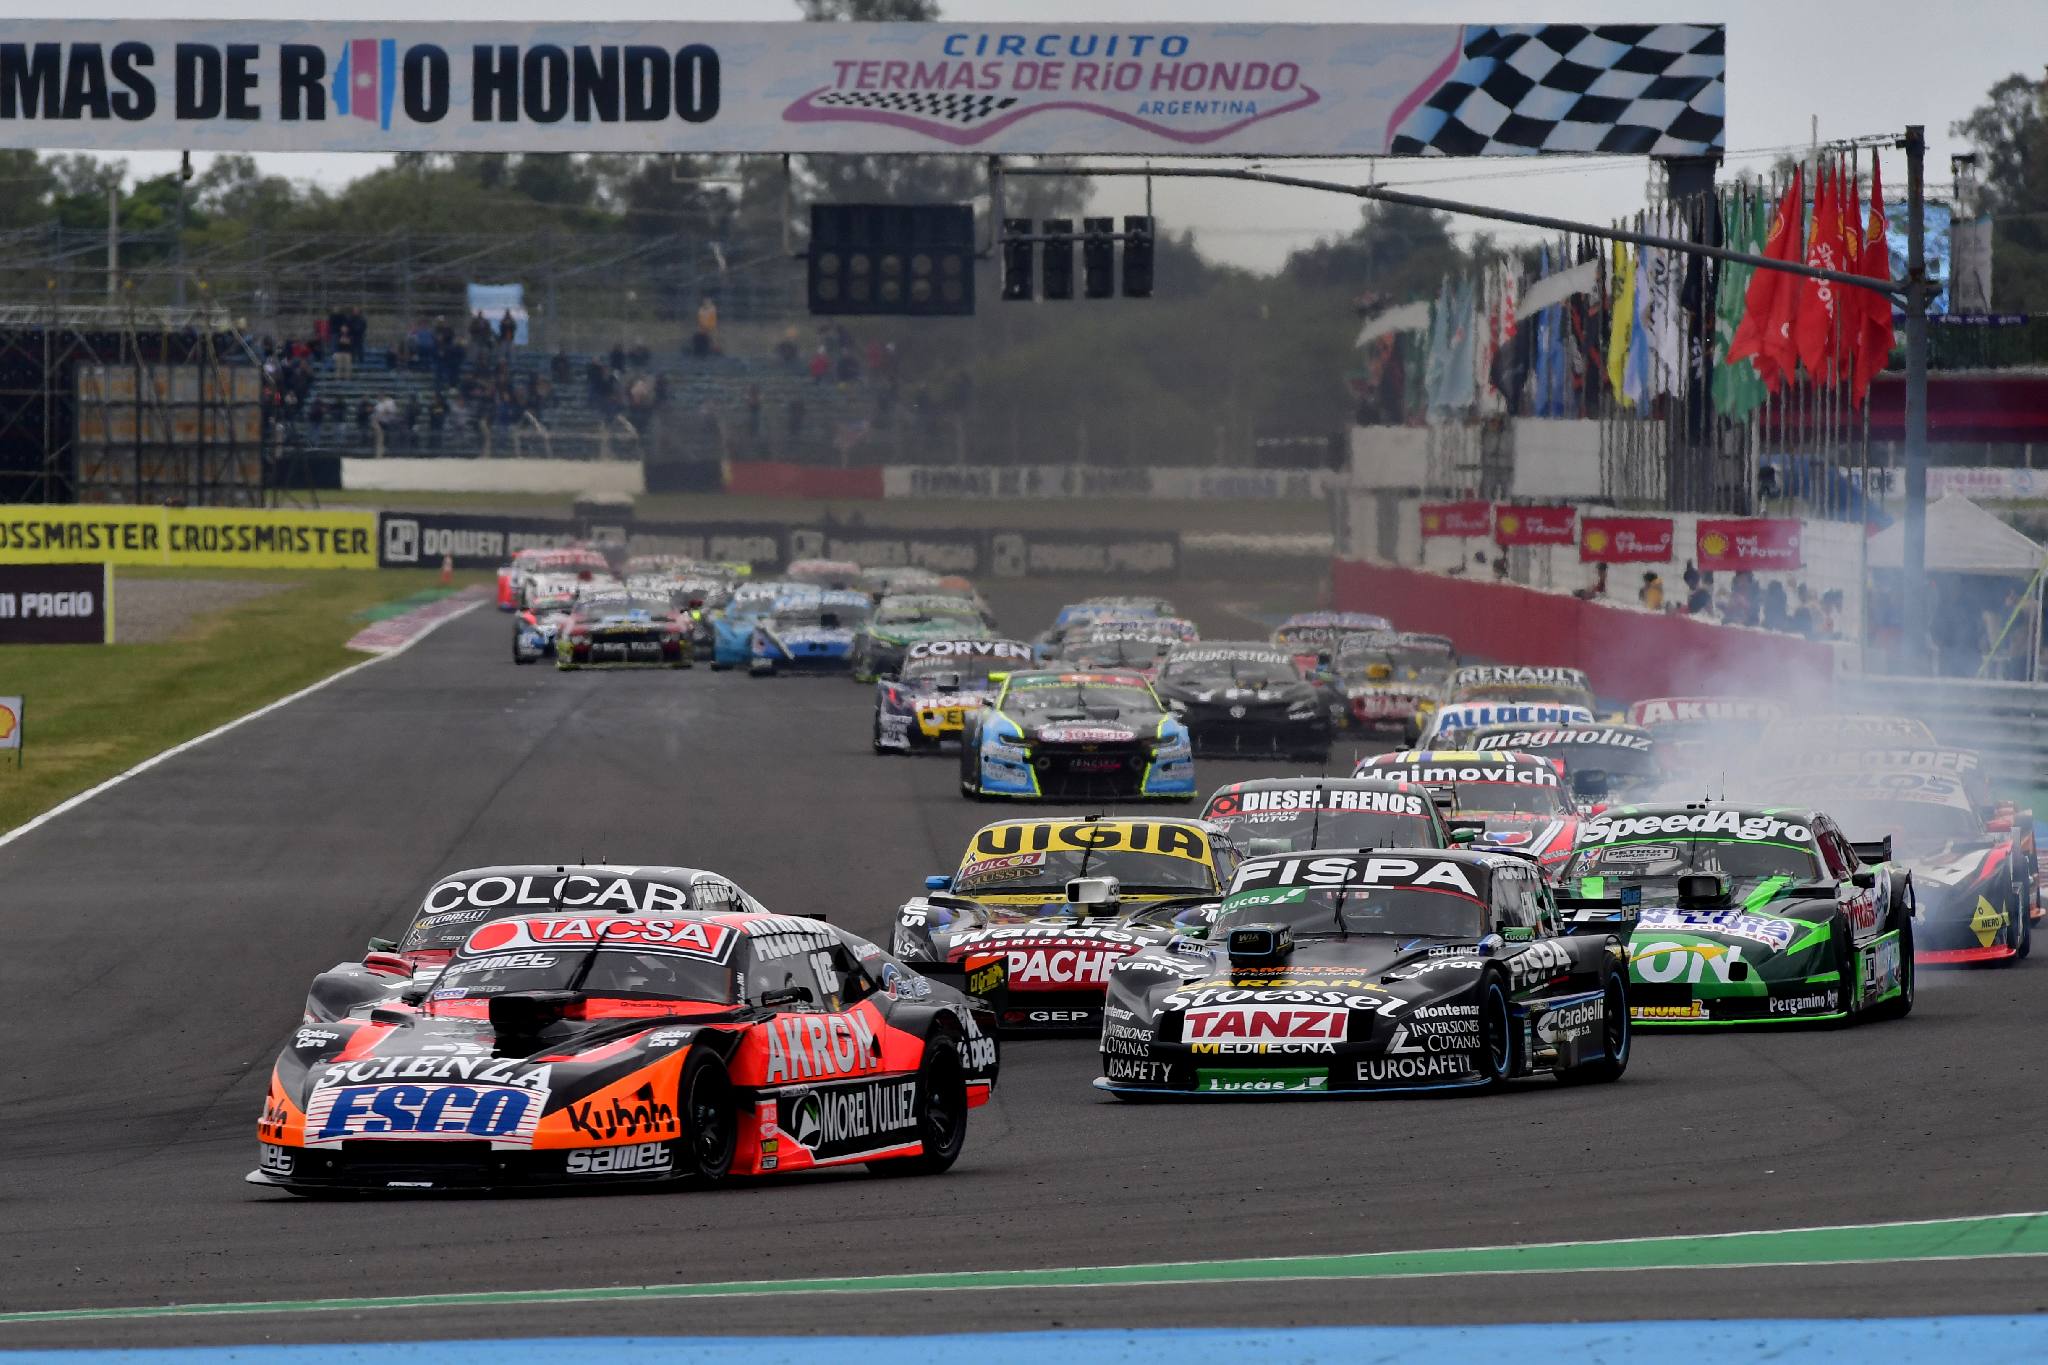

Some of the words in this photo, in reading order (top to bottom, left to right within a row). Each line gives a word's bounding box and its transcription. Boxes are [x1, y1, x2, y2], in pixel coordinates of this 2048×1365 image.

[943, 34, 1190, 58] CIRCUITO
[174, 44, 260, 121] DE
[472, 44, 721, 124] HONDO
[833, 60, 1002, 92] TERMAS
[1011, 61, 1064, 92] DE
[1150, 61, 1300, 92] HONDO
[1137, 100, 1258, 116] ARGENTINA
[168, 524, 369, 555] CROSSMASTER
[22, 591, 94, 618] PAGIO
[910, 640, 1031, 661] CORVEN
[1458, 666, 1586, 683] RENAULT
[1477, 727, 1654, 752] magnoluz
[1356, 764, 1557, 787] Haimovich
[1328, 790, 1422, 816] FRENOS
[1249, 815, 1299, 824] AUTOS
[1583, 810, 1812, 844] SpeedAgro
[967, 855, 1036, 874] DULCOR
[1229, 857, 1478, 897] FISPA
[1220, 895, 1270, 914] Lucas
[540, 918, 711, 948] TACSA
[964, 938, 1134, 951] LUBRICANTES
[1510, 940, 1572, 991] FISPA
[1152, 987, 1408, 1018] Stoessel
[1414, 1004, 1480, 1020] Montemar
[1557, 998, 1604, 1029] Carabelli
[1769, 992, 1825, 1015] Pergamino
[1029, 1011, 1089, 1022] GEP
[1184, 1010, 1347, 1038] TANZI
[1410, 1019, 1480, 1037] INVERSIONES
[296, 1037, 327, 1049] Cars
[297, 1028, 340, 1041] Golden
[1428, 1034, 1481, 1052] CUYANAS
[315, 1055, 553, 1091] SCIENZA
[1356, 1054, 1472, 1081] EUROSAFETY
[1209, 1078, 1285, 1091] Lucas
[824, 1091, 870, 1143] MOREL
[868, 1081, 918, 1134] VULLIEZ
[566, 1142, 671, 1174] samet
